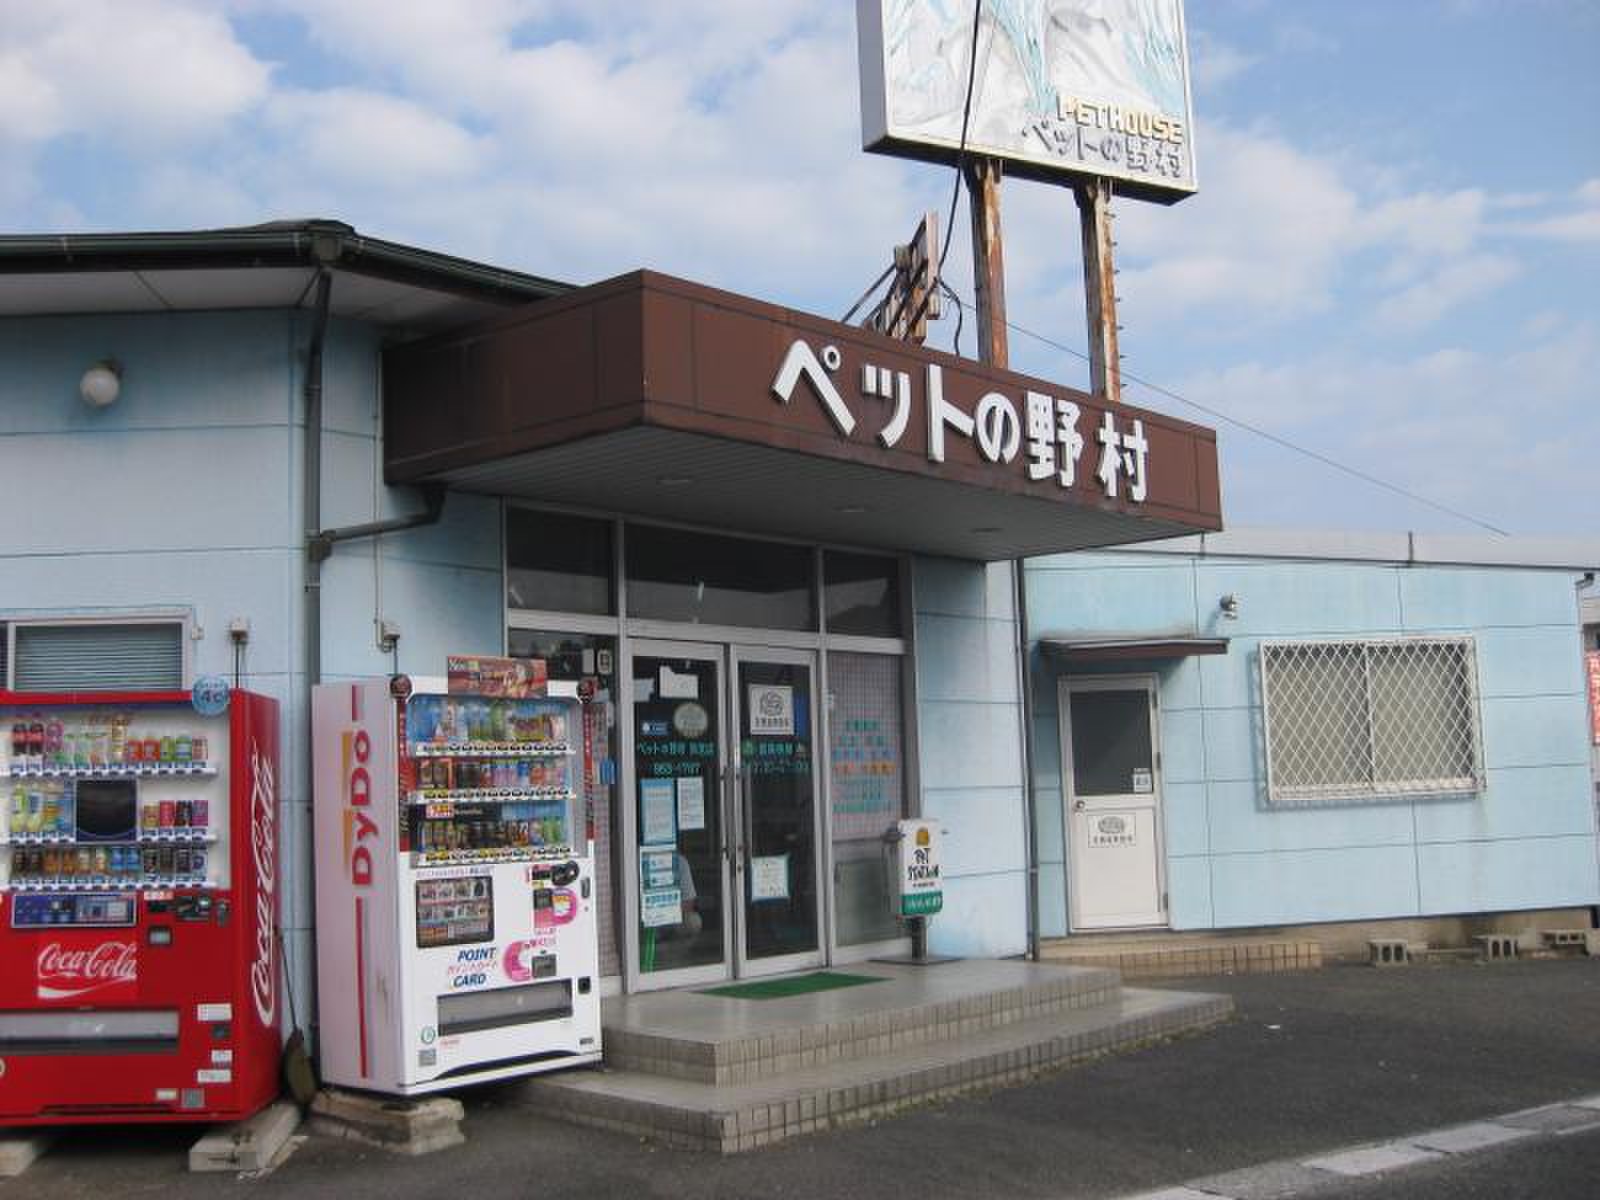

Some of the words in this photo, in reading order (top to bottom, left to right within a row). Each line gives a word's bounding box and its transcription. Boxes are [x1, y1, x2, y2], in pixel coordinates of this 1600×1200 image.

[1021, 121, 1184, 178] ペットの野村
[771, 339, 1149, 502] ペットの野村
[252, 736, 276, 1028] Coca-Cola
[37, 941, 138, 981] Coca-Cola
[457, 947, 497, 962] POINT
[453, 974, 487, 988] CARD
